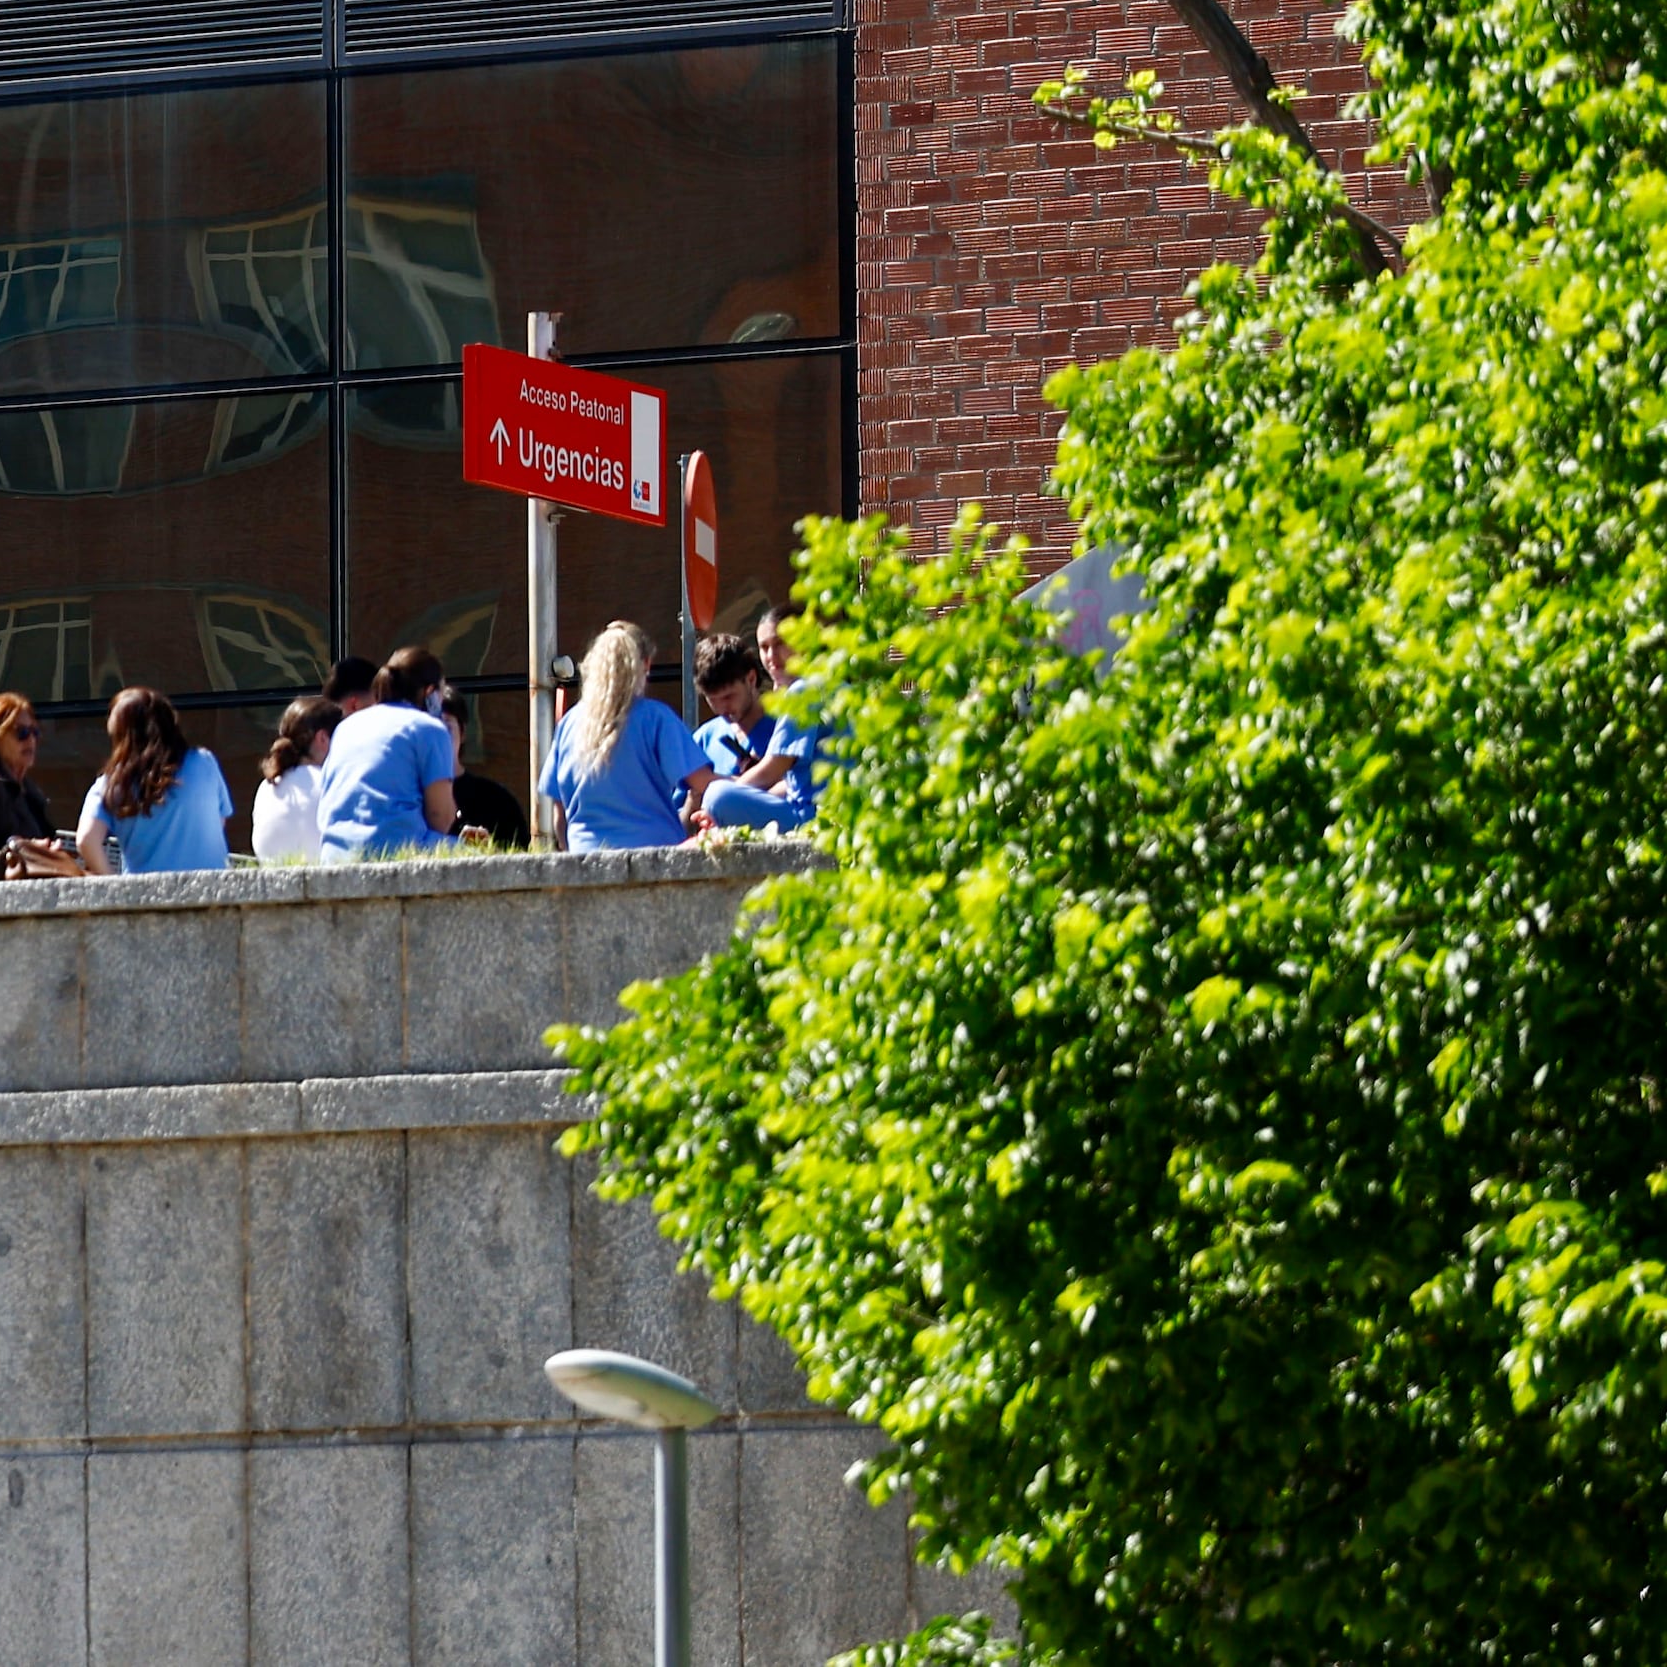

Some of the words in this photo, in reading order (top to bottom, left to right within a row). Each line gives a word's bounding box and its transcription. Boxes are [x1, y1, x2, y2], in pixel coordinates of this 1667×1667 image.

[520, 378, 567, 412] Acceso
[570, 390, 624, 426] Peatonal
[518, 426, 624, 491] Urgencias
